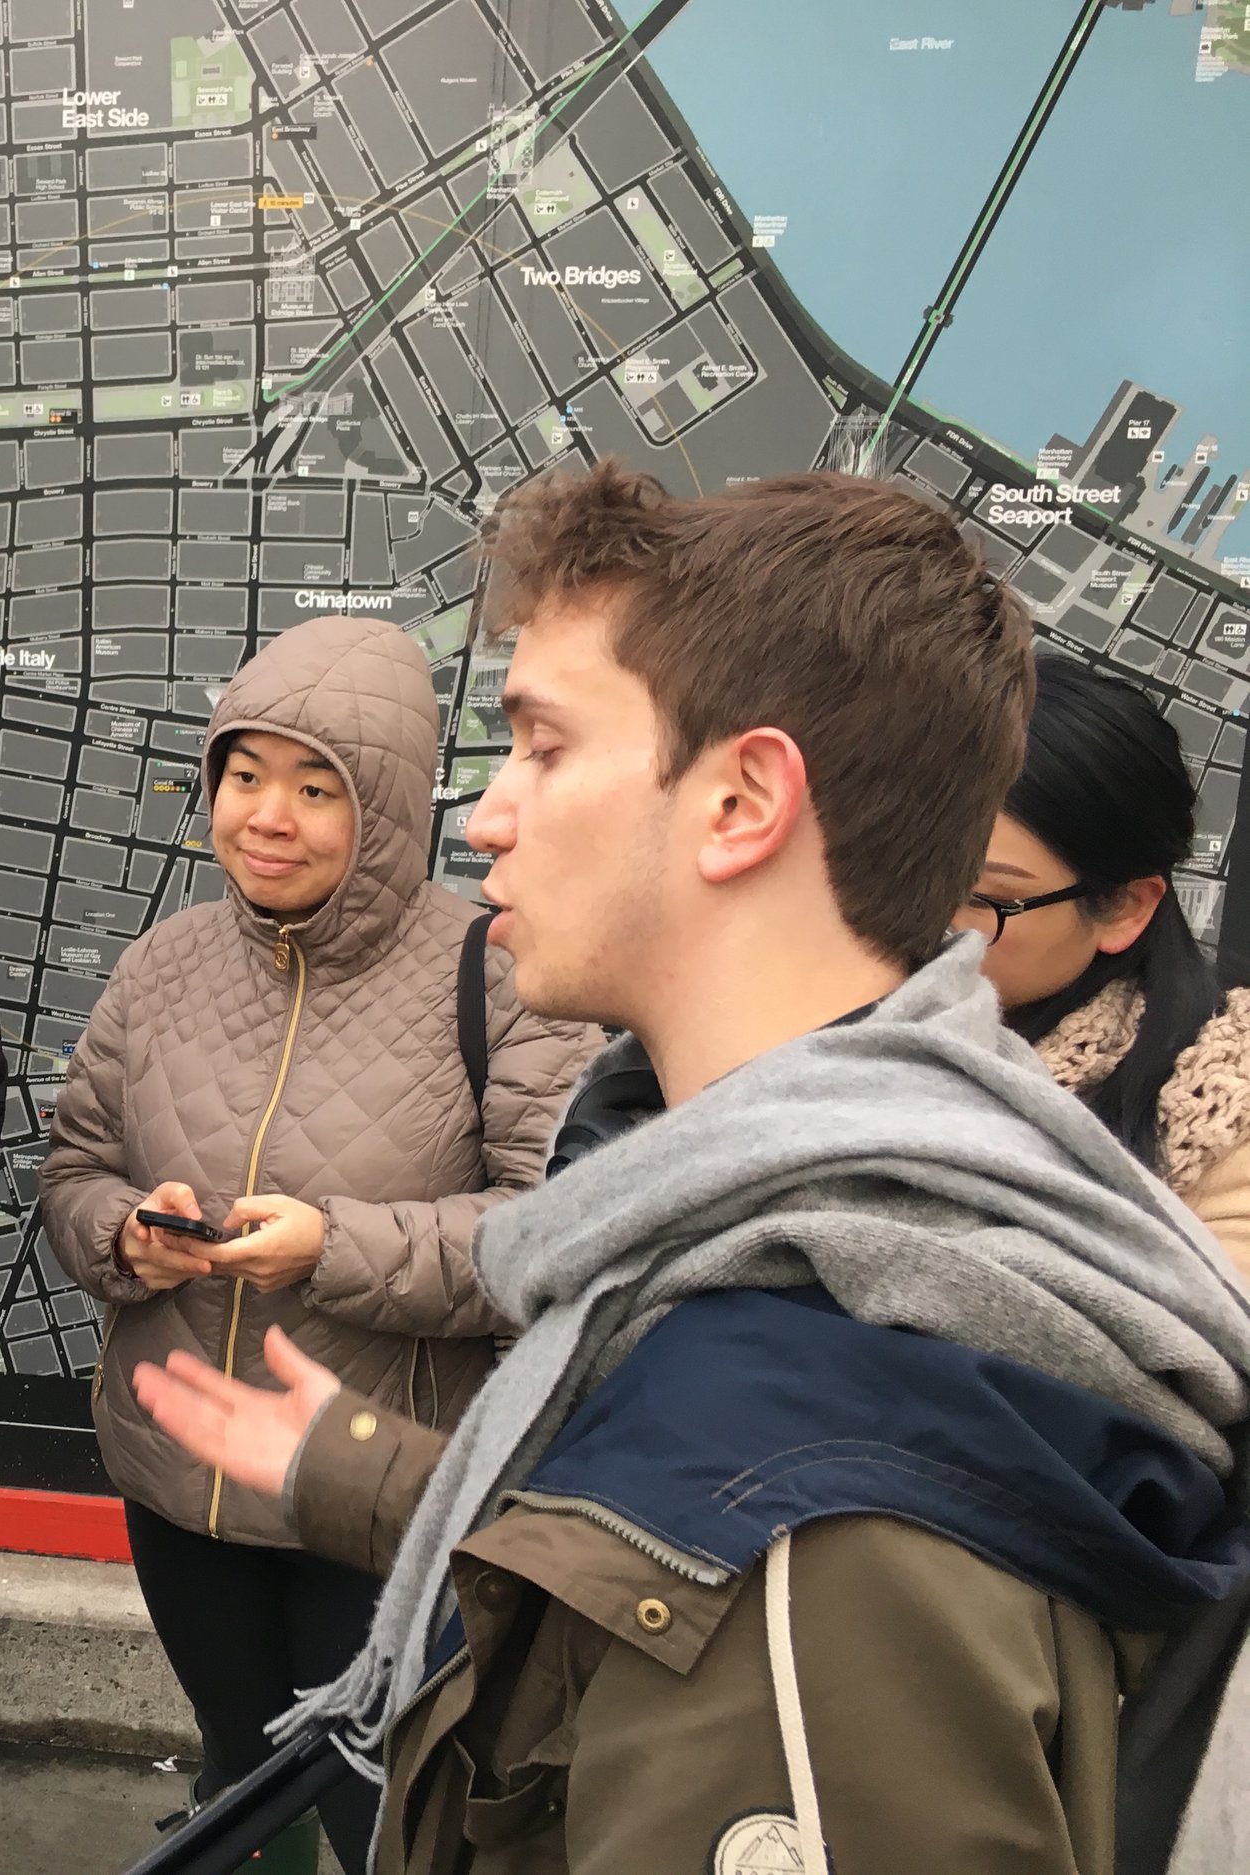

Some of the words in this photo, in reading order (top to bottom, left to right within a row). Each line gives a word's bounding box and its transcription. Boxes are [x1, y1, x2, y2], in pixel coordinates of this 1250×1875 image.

[890, 38, 918, 51] East
[921, 37, 955, 50] River
[62, 88, 121, 106] Lower
[62, 110, 104, 128] East
[107, 108, 150, 127] Side
[521, 266, 560, 285] Two
[564, 266, 641, 289] Bridges
[991, 484, 1053, 503] South
[1056, 485, 1122, 503] Street
[988, 507, 1073, 527] Seaport
[294, 591, 393, 610] Chinatown
[19, 649, 56, 670] Italy
